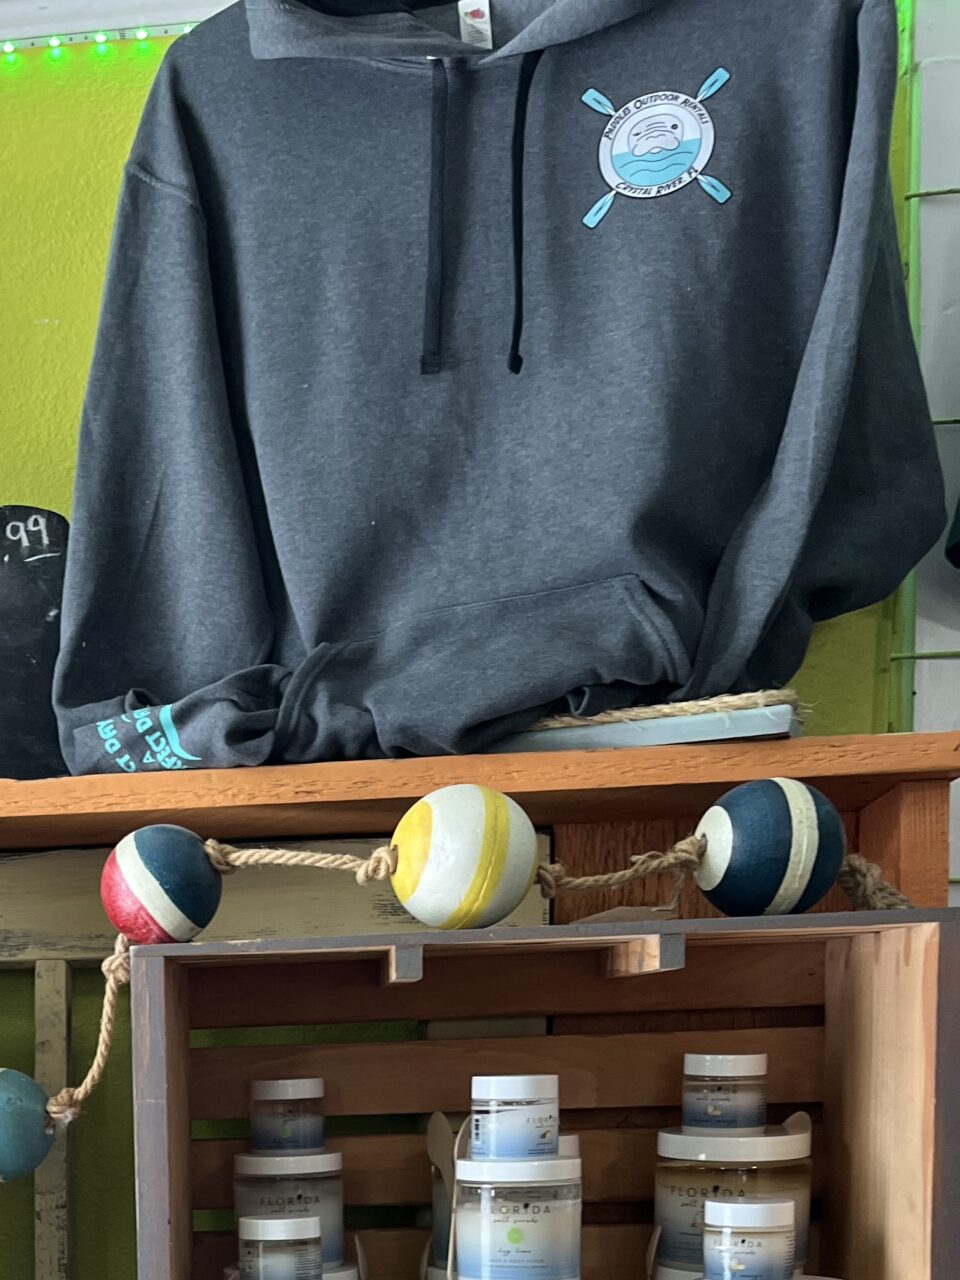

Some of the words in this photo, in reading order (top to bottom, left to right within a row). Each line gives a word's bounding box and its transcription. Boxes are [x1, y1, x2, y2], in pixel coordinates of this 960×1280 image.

[603, 105, 632, 141] PADDLES
[633, 92, 682, 110] OUTDOOR
[682, 98, 710, 125] RENTALS
[614, 181, 653, 196] CRYSTAL
[688, 167, 699, 181] FL
[489, 1202, 552, 1215] LORIDA
